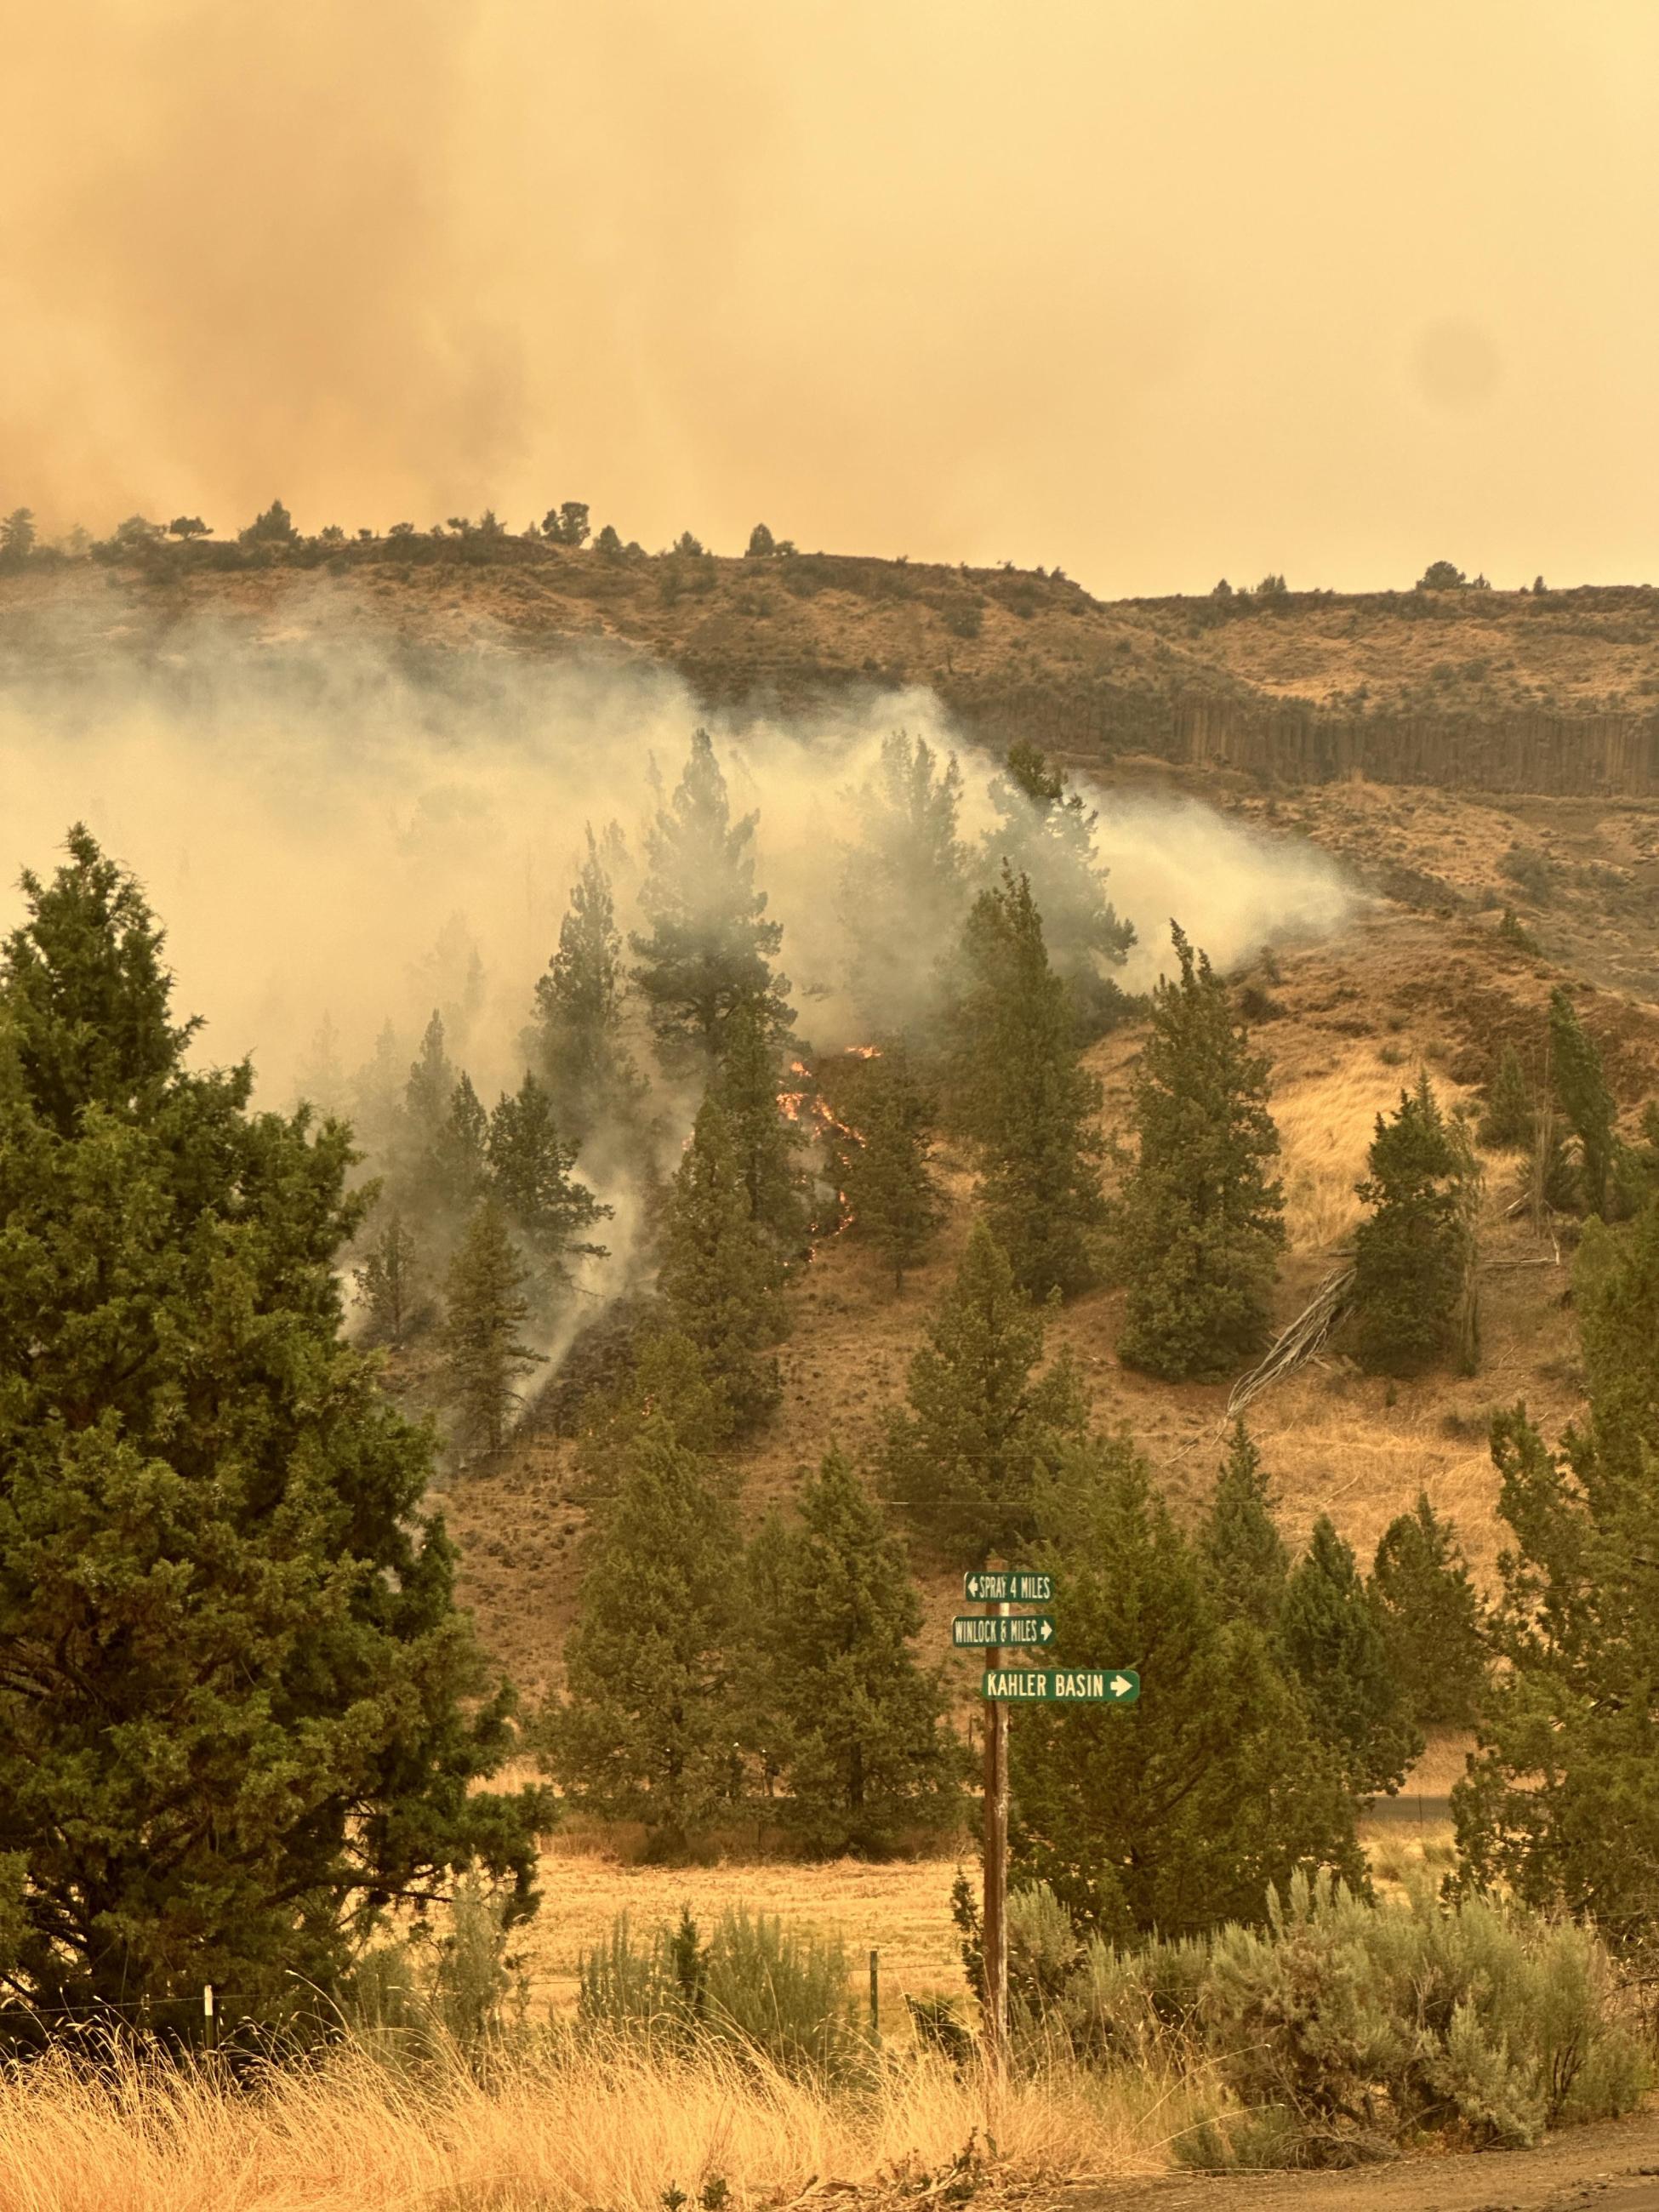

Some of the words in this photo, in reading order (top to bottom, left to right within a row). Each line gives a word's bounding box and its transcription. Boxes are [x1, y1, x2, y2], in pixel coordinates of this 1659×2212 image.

[979, 1576, 1007, 1599] SPRAY
[1010, 1576, 1017, 1599] 4
[1021, 1576, 1050, 1599] MILES
[955, 1621, 996, 1643] WINLOCK
[1011, 1620, 1037, 1642] MILES
[987, 1673, 1046, 1696] KAHLER
[1055, 1673, 1103, 1697] BASIN
